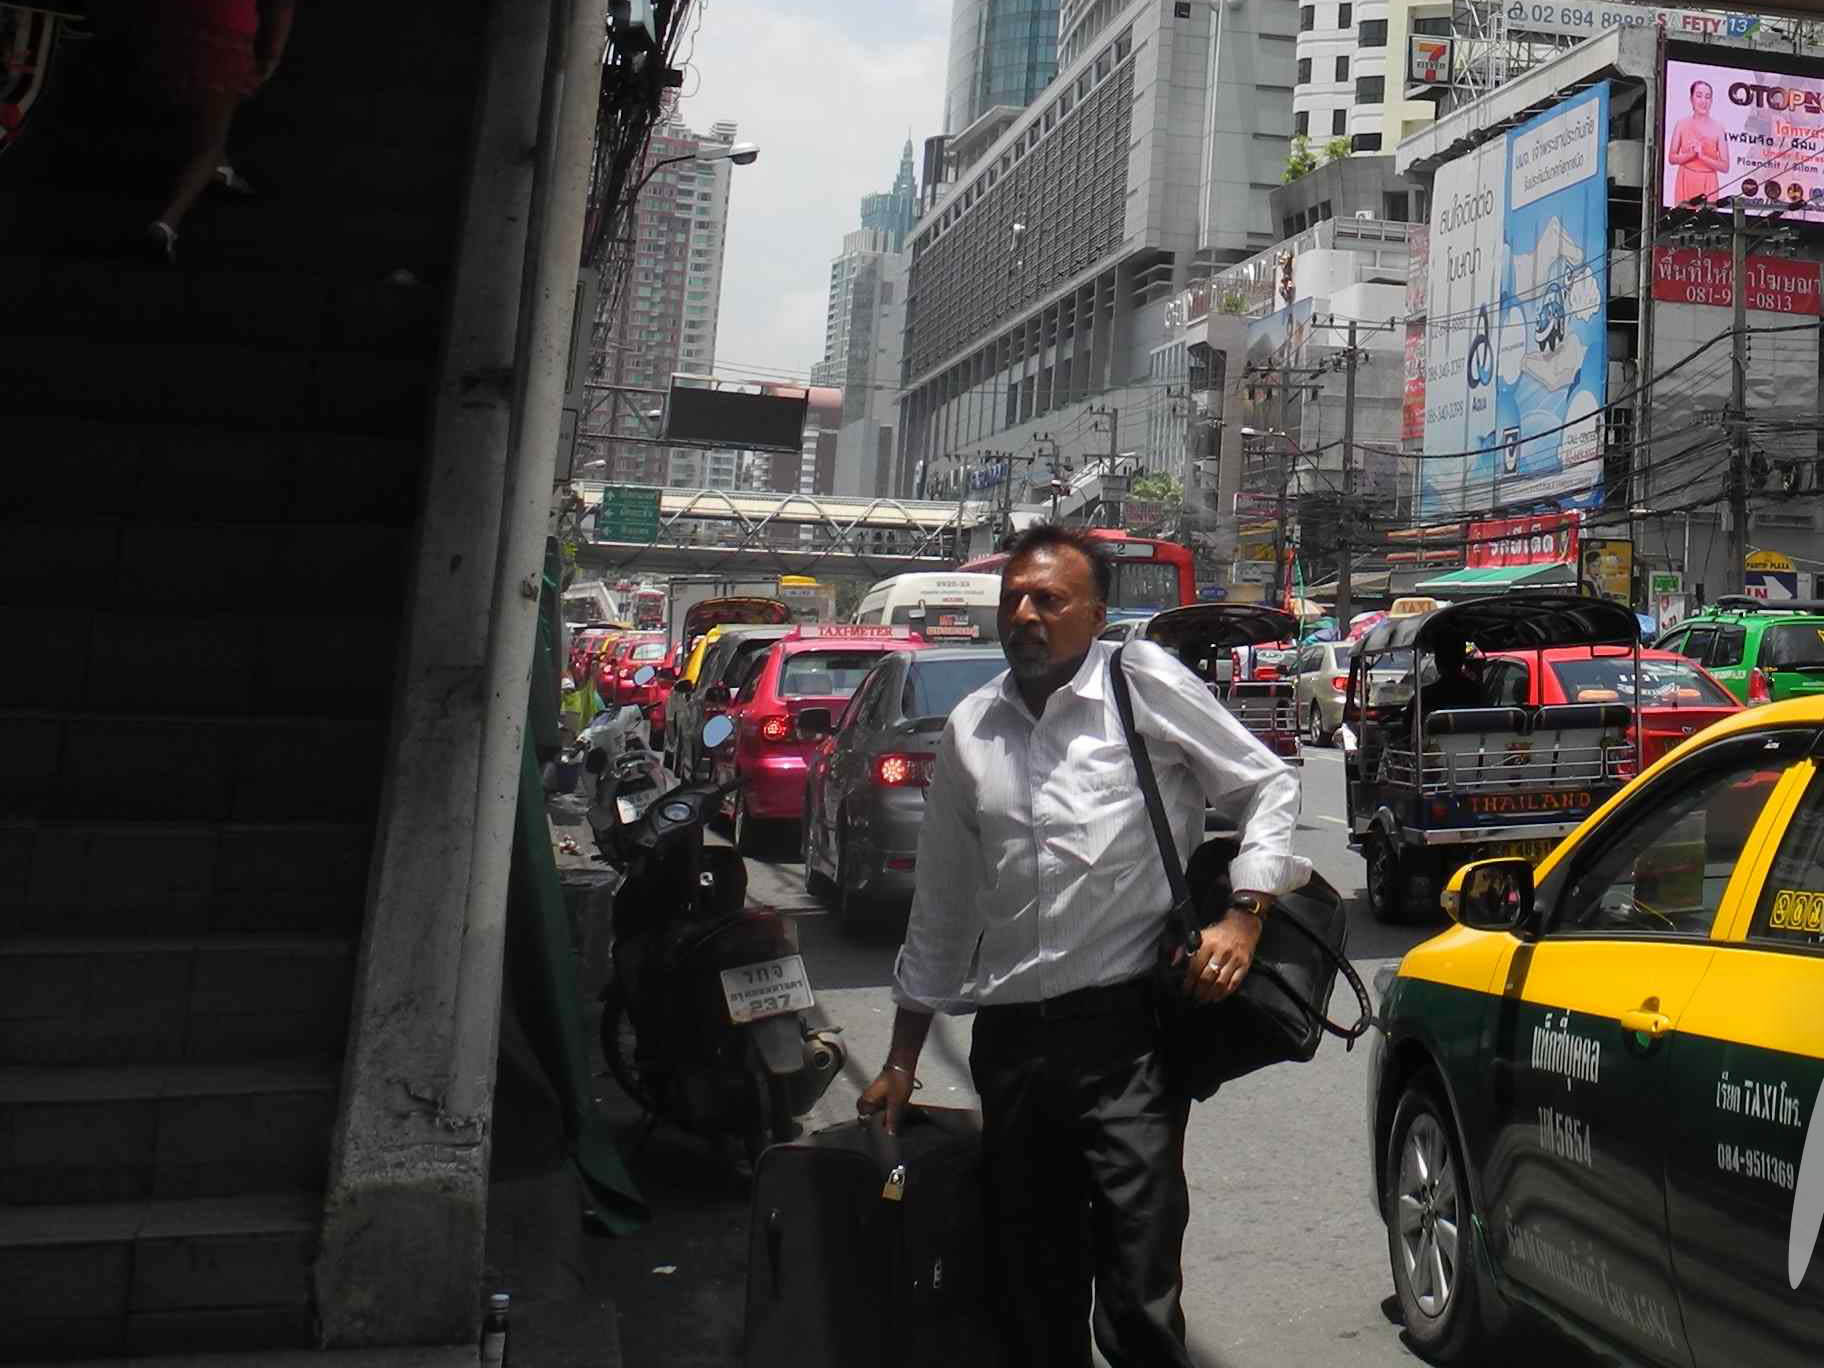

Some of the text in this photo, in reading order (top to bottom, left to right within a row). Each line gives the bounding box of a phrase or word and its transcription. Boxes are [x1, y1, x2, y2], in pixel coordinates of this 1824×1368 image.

[1531, 4, 1554, 24] 02
[1561, 6, 1594, 27] 694
[1686, 285, 1792, 311] 081-9-0813
[819, 626, 893, 637] TAXI-METER
[1471, 790, 1592, 813] THAILAND
[1744, 1078, 1776, 1121] TAXI
[1716, 1143, 1795, 1191] 084-9511369
